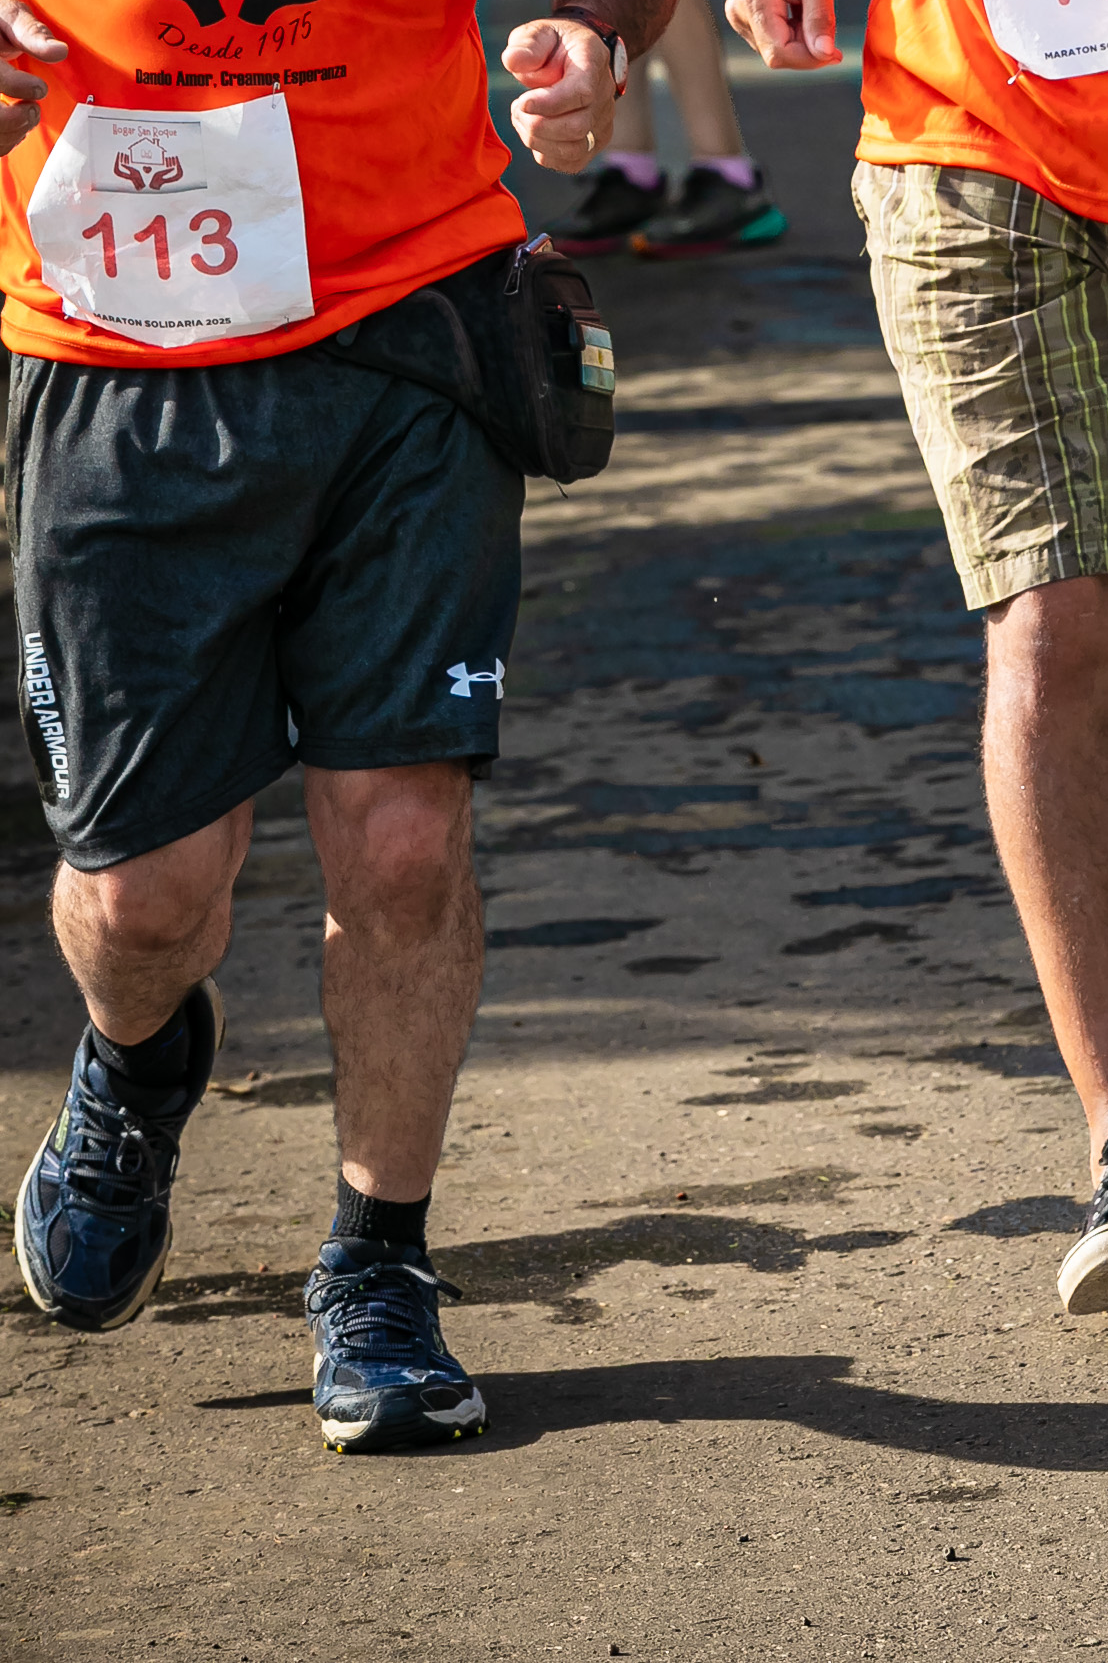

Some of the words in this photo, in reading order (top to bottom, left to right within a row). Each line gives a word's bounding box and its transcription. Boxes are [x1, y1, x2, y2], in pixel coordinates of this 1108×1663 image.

[157, 21, 243, 59] Desde
[258, 11, 312, 56] 1975
[1044, 44, 1098, 60] MARATON
[136, 69, 172, 86] Dando
[220, 70, 280, 87] Creamos
[283, 64, 347, 86] Esperanza
[137, 125, 152, 137] San
[152, 126, 178, 139] Roque
[82, 209, 239, 280] 113
[93, 312, 142, 327] MARATON
[144, 319, 203, 329] SOLIDARIA
[205, 317, 232, 326] 2025
[24, 632, 57, 708] UNDER
[33, 707, 71, 800] ARMOUR
